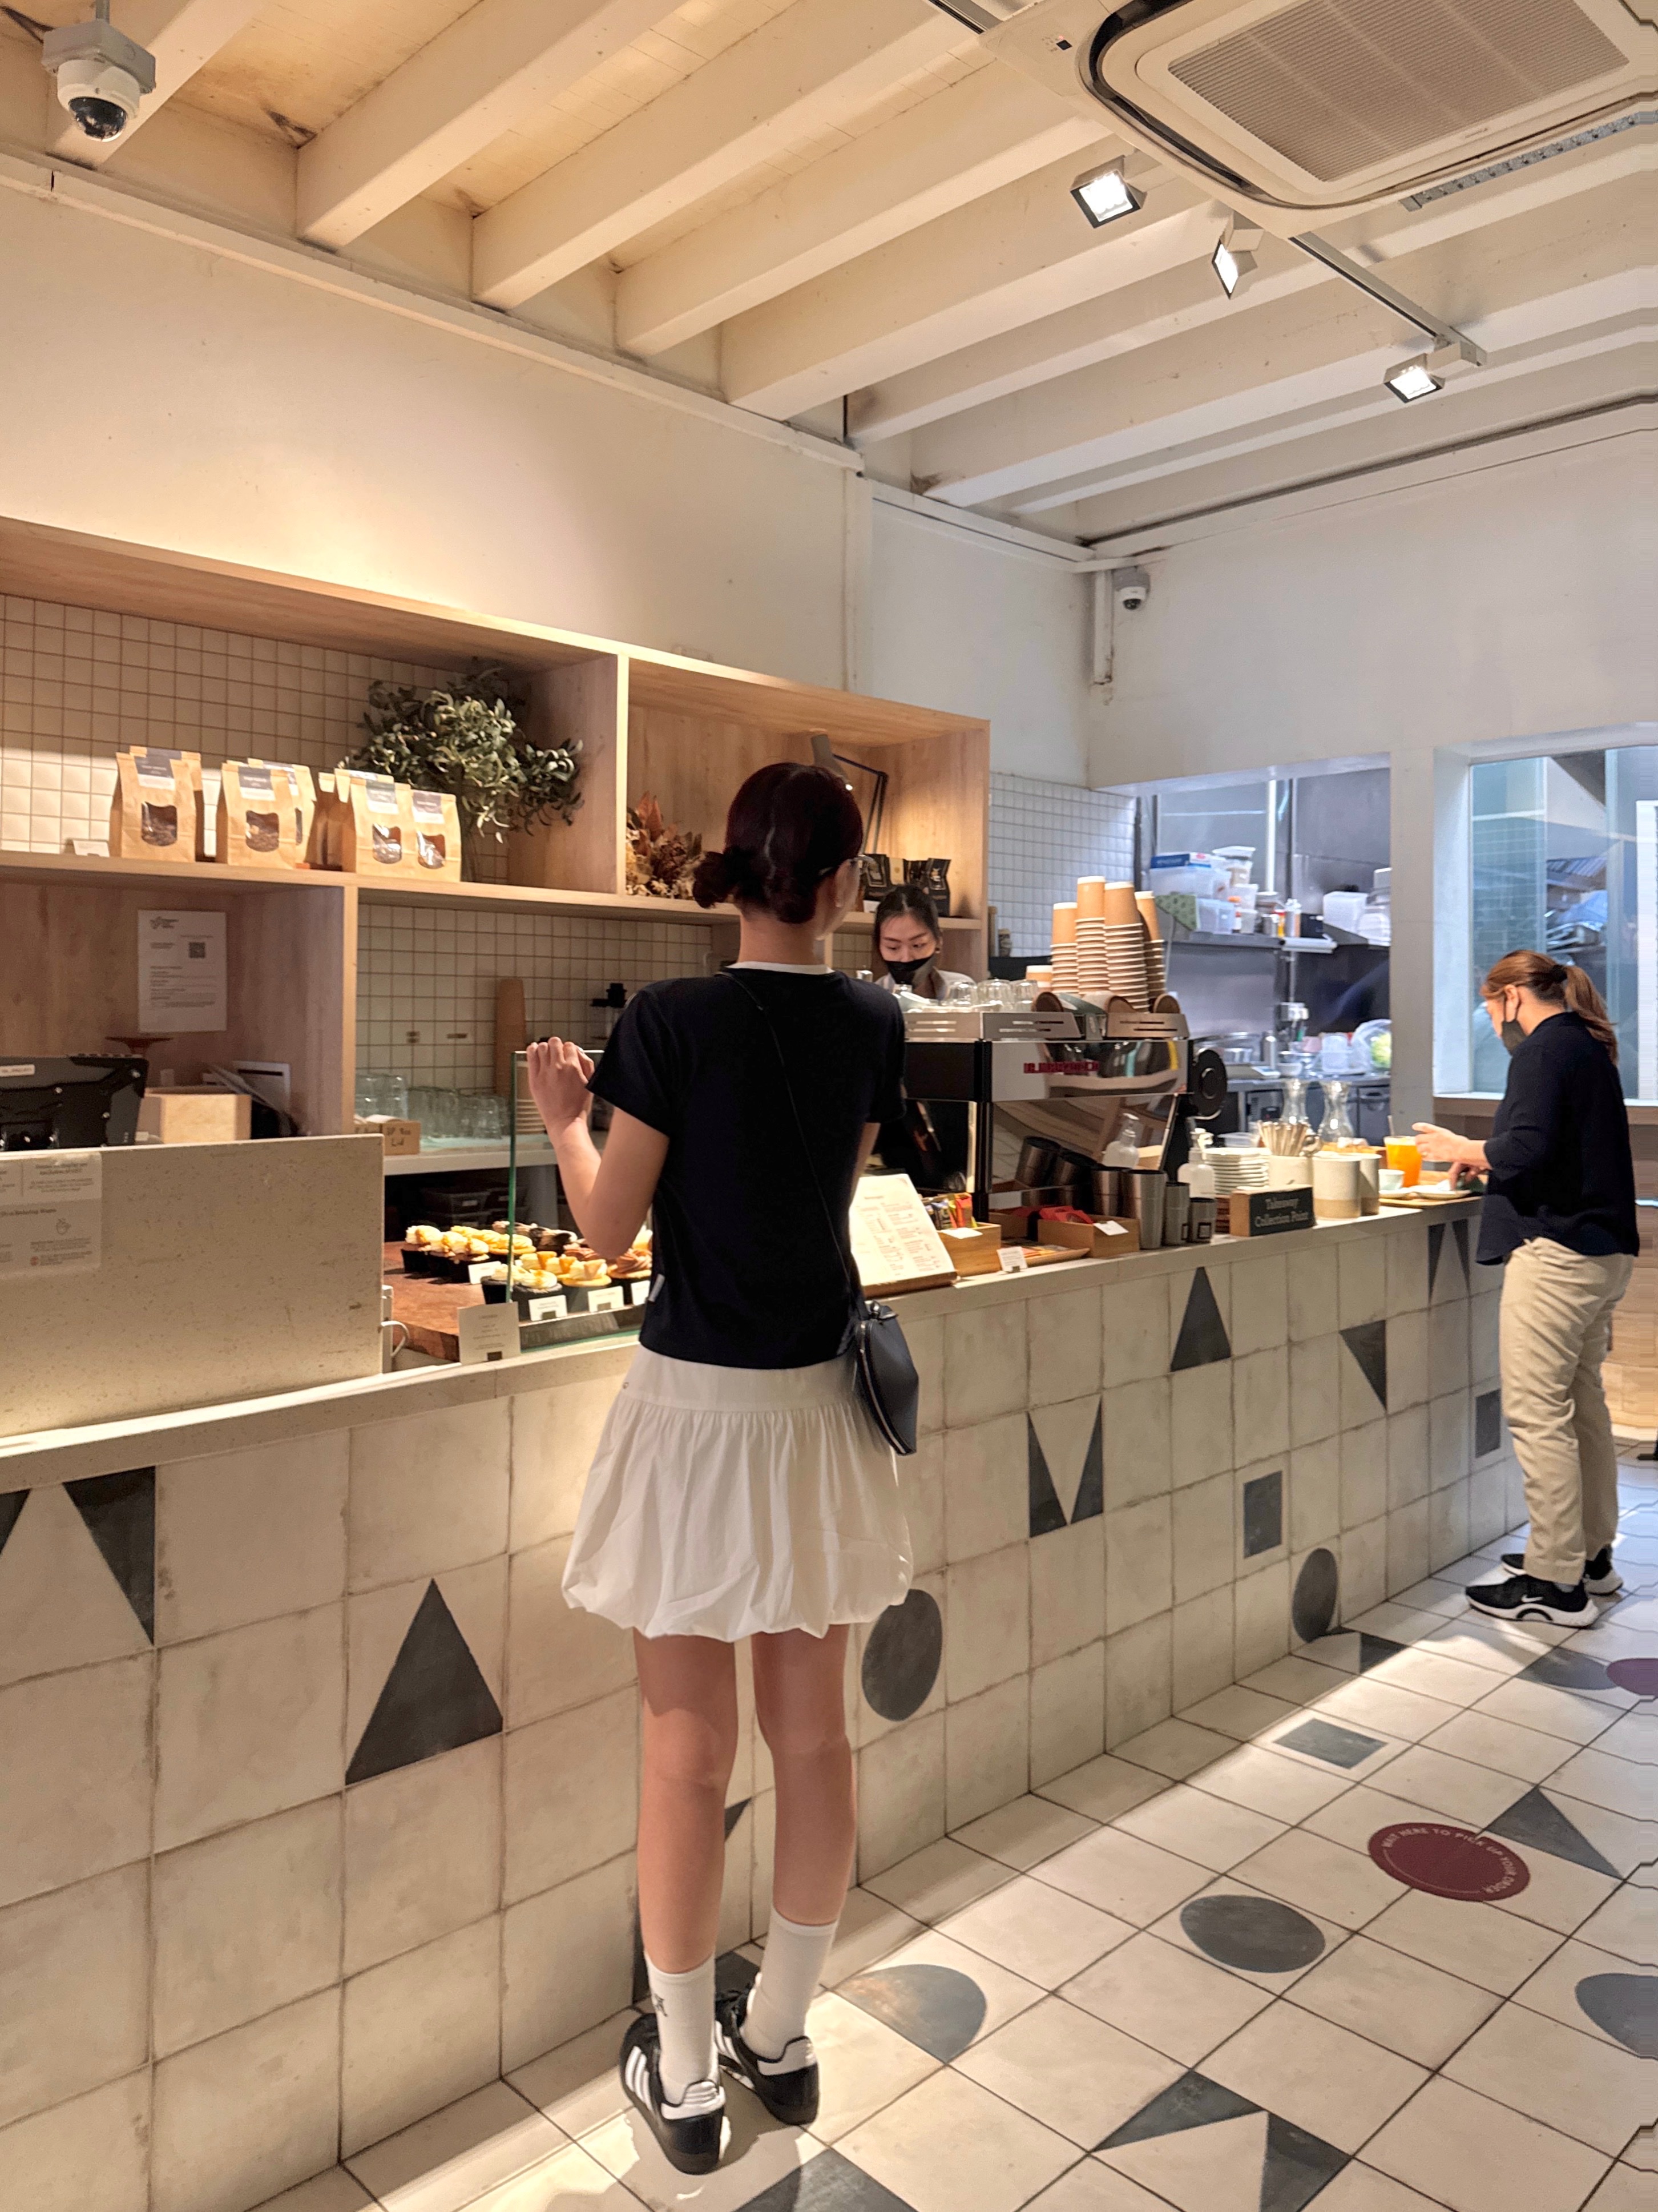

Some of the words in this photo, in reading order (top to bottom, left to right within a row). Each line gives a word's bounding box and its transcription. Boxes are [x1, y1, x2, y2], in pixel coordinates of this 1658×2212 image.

[1265, 1197, 1299, 1210] Takeaway
[1256, 1214, 1290, 1227] Collection
[1290, 1210, 1309, 1223] Point
[1398, 1827, 1429, 1836] HERE
[1381, 1833, 1401, 1848] WAIT
[1455, 1832, 1486, 1847] PICK
[1486, 1846, 1503, 1856] UP
[1500, 1856, 1518, 1876] YOUR
[1482, 1876, 1515, 1893] ORDER
